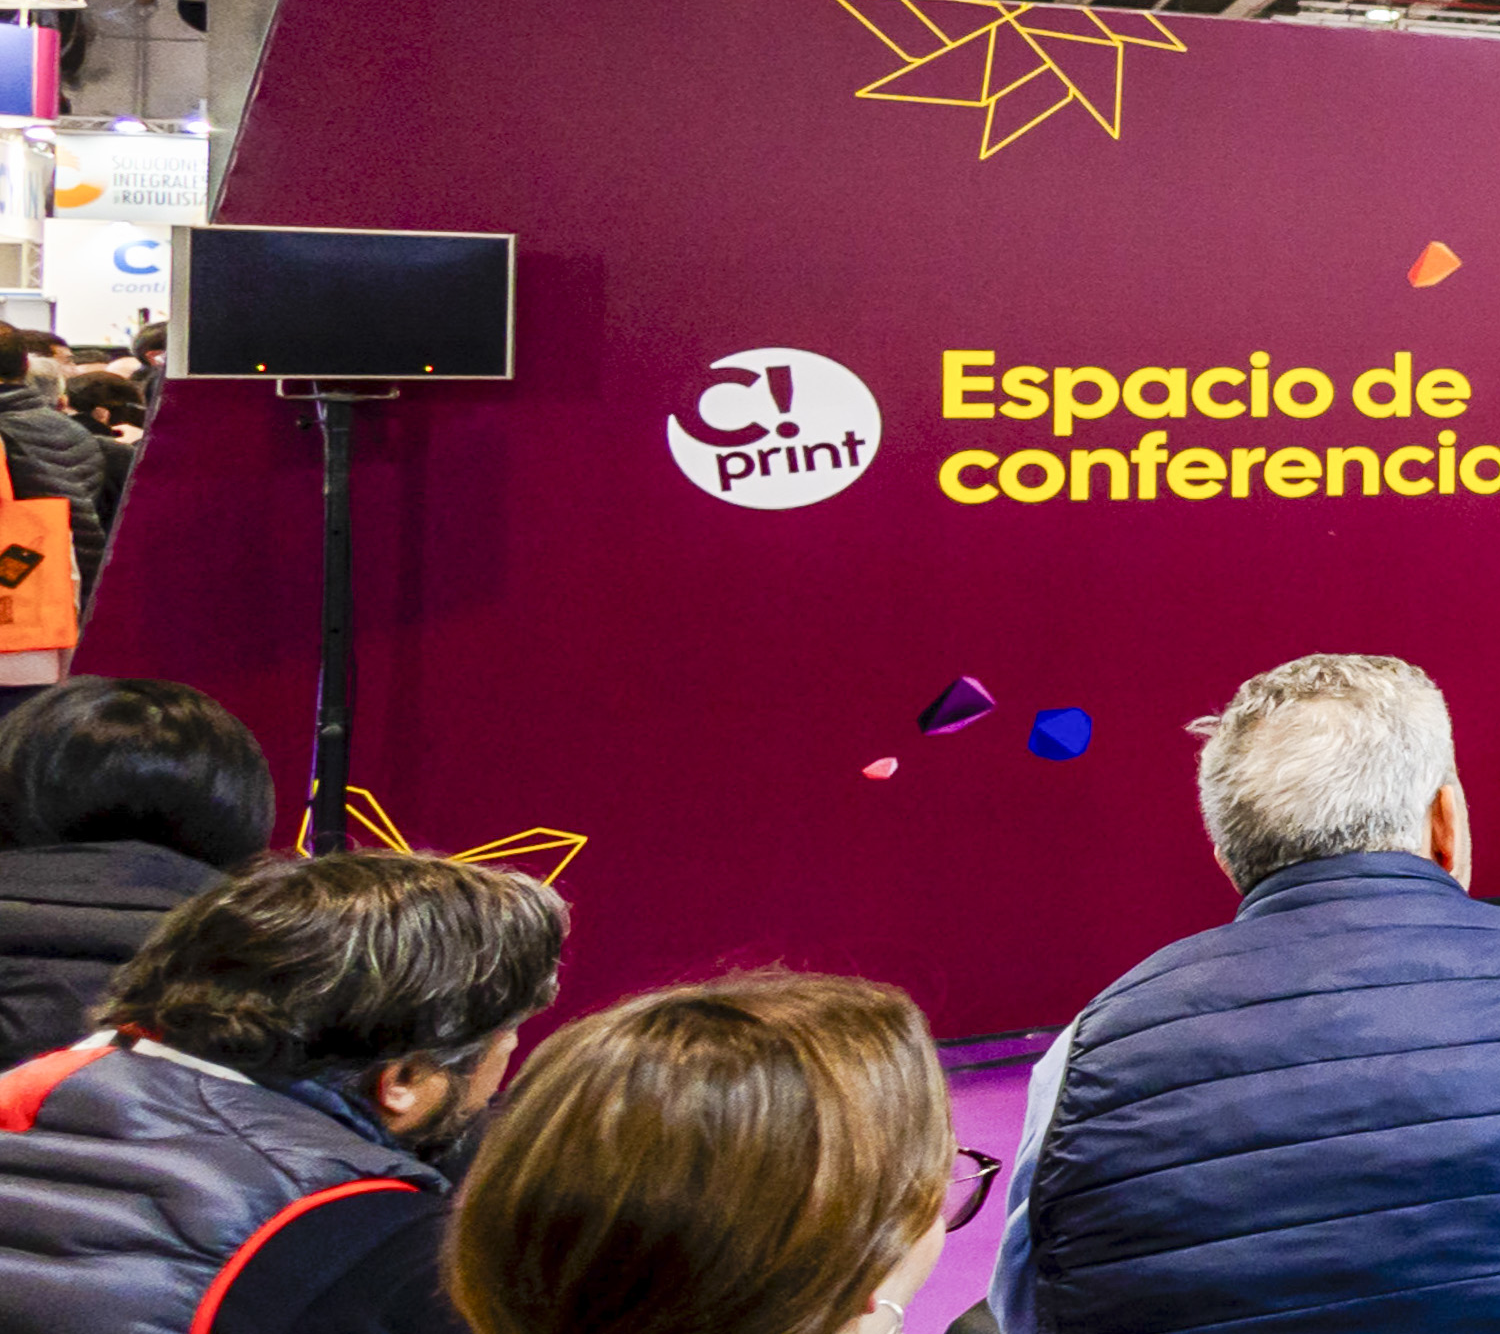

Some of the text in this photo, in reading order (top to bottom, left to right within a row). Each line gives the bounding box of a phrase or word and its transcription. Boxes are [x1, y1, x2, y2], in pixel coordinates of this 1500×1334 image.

[942, 350, 1472, 435] Espacio de
[715, 430, 866, 492] print
